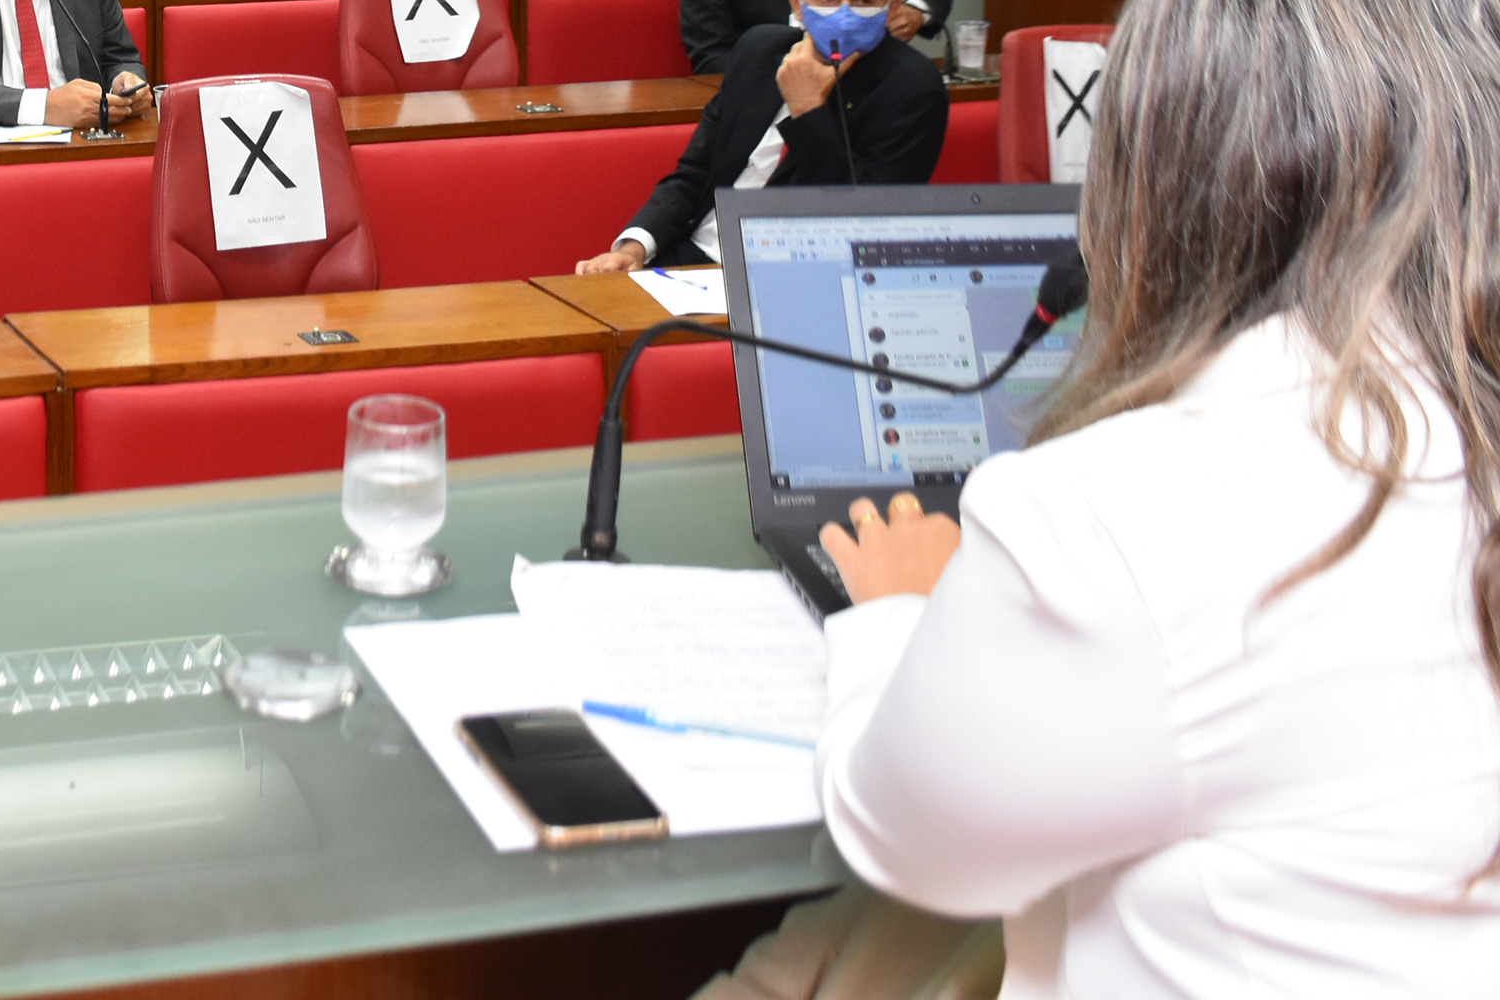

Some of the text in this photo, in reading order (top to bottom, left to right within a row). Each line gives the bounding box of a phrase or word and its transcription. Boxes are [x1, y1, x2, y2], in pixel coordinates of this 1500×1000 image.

[219, 109, 297, 196] X
[246, 214, 286, 225] NÃO SENTAR
[773, 494, 816, 507] Lenovo
